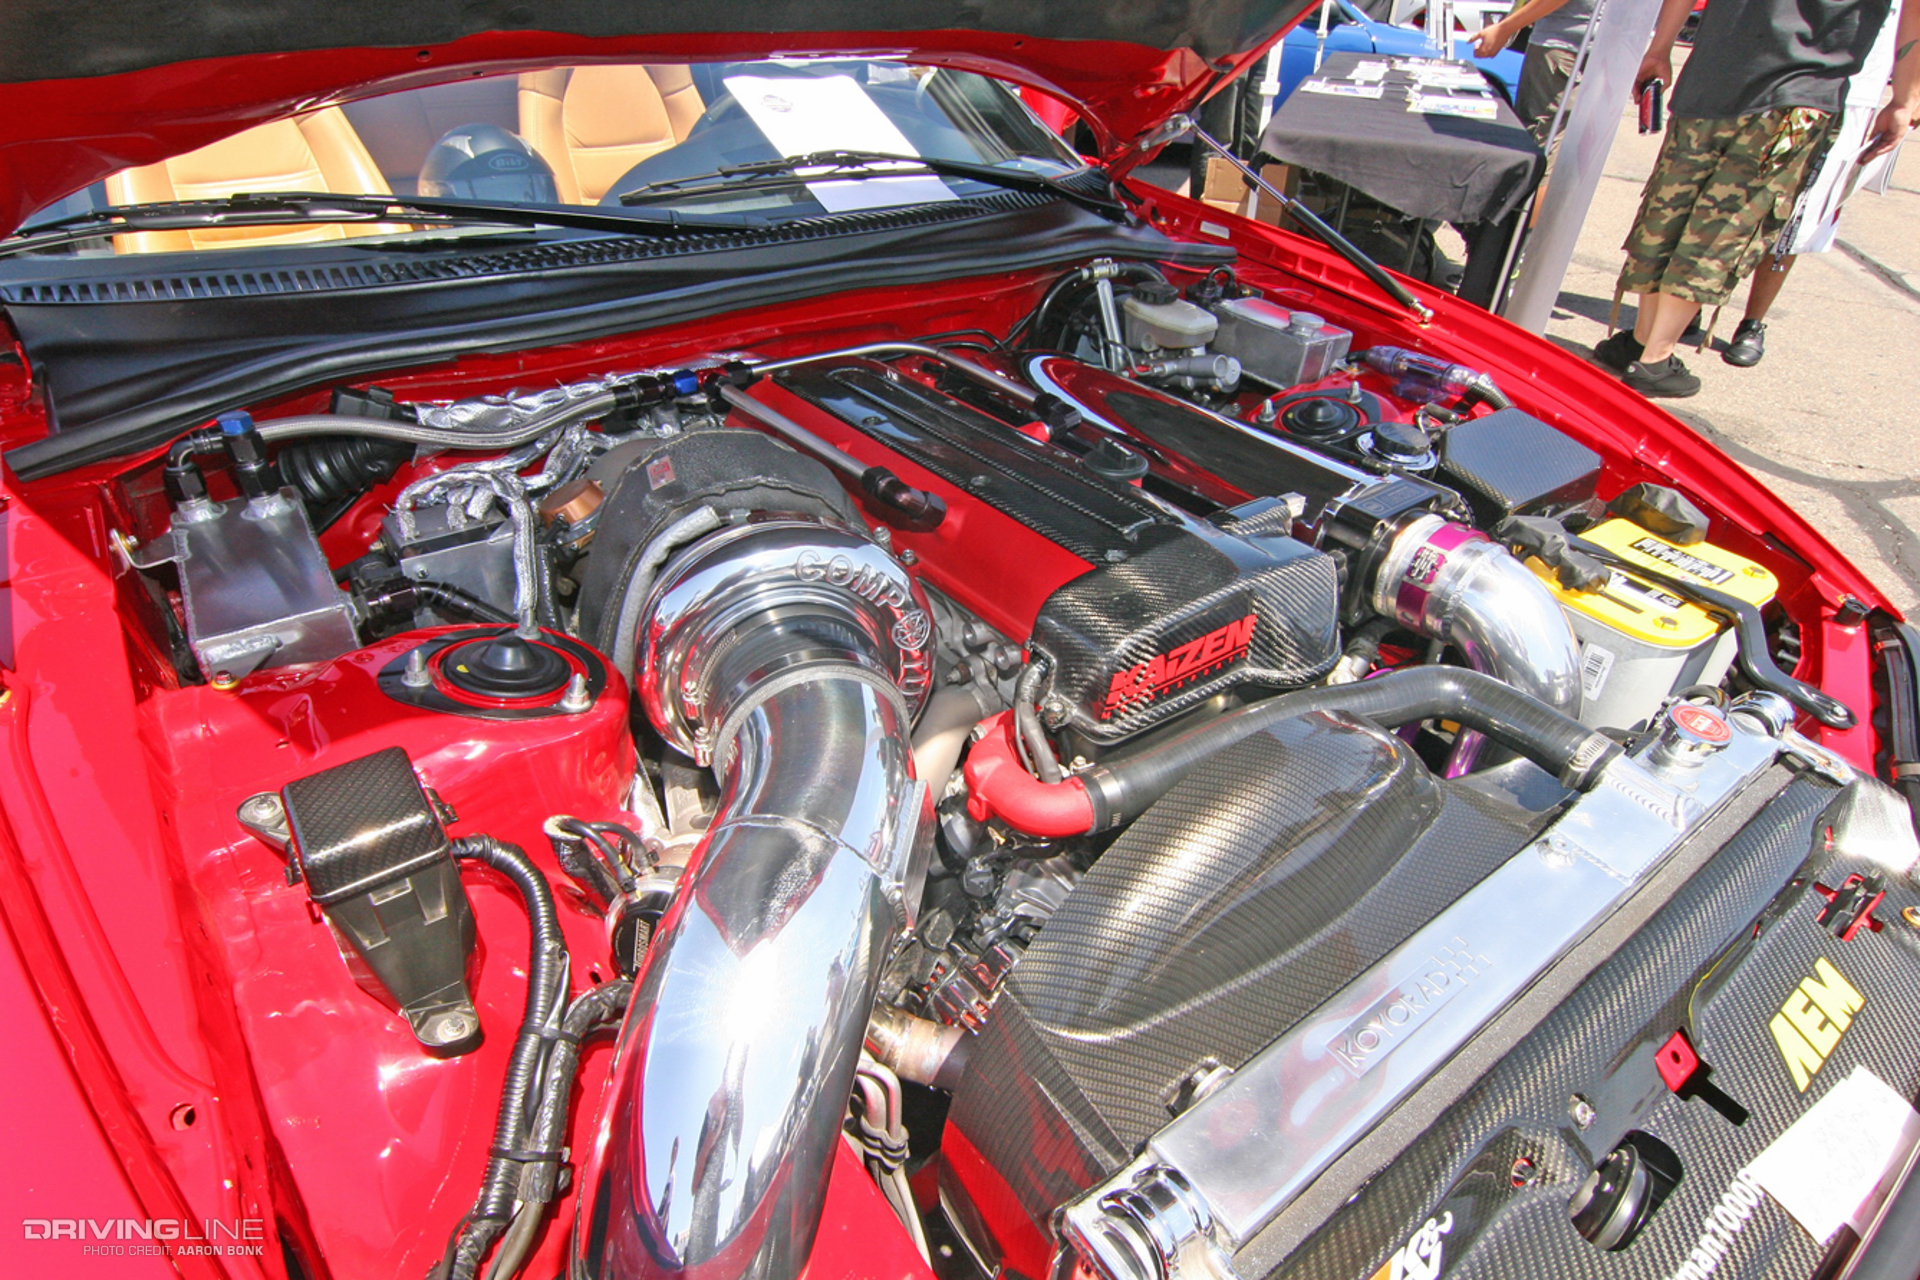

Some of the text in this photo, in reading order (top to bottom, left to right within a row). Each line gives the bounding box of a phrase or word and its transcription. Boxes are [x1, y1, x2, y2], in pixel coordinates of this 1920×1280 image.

[796, 549, 906, 607] COMP
[1336, 971, 1450, 1069] KOYORAD
[1768, 956, 1867, 1093] AEM
